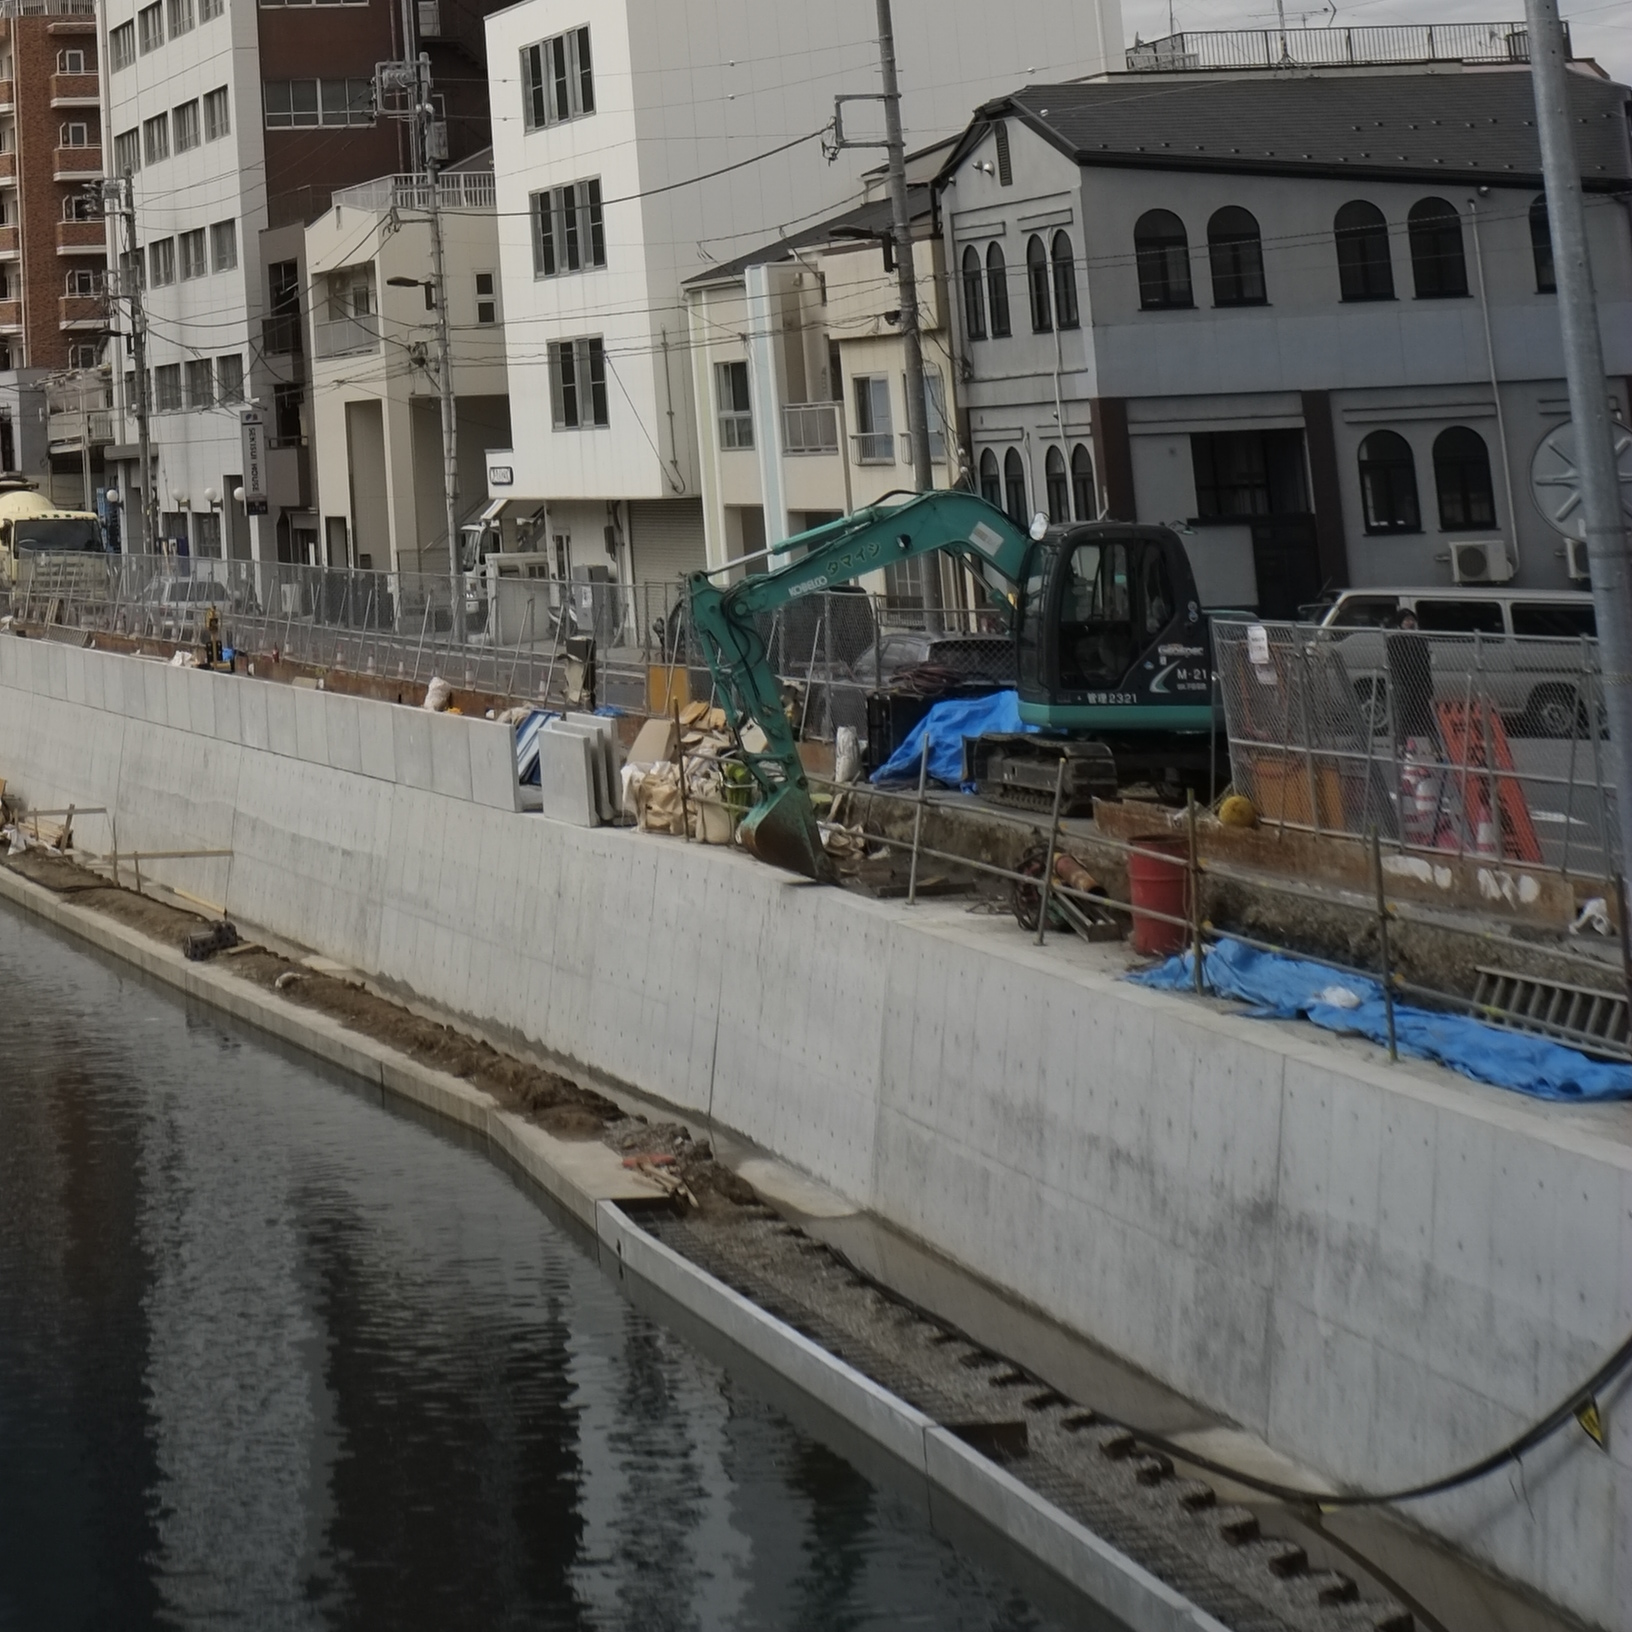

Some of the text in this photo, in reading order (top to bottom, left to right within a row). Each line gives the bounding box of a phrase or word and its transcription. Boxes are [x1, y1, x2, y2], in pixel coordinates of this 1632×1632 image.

[249, 428, 257, 459] SEKISUI
[251, 464, 260, 492] HOUSE
[827, 543, 880, 574] タマイシ
[788, 575, 828, 597] KOBELCO
